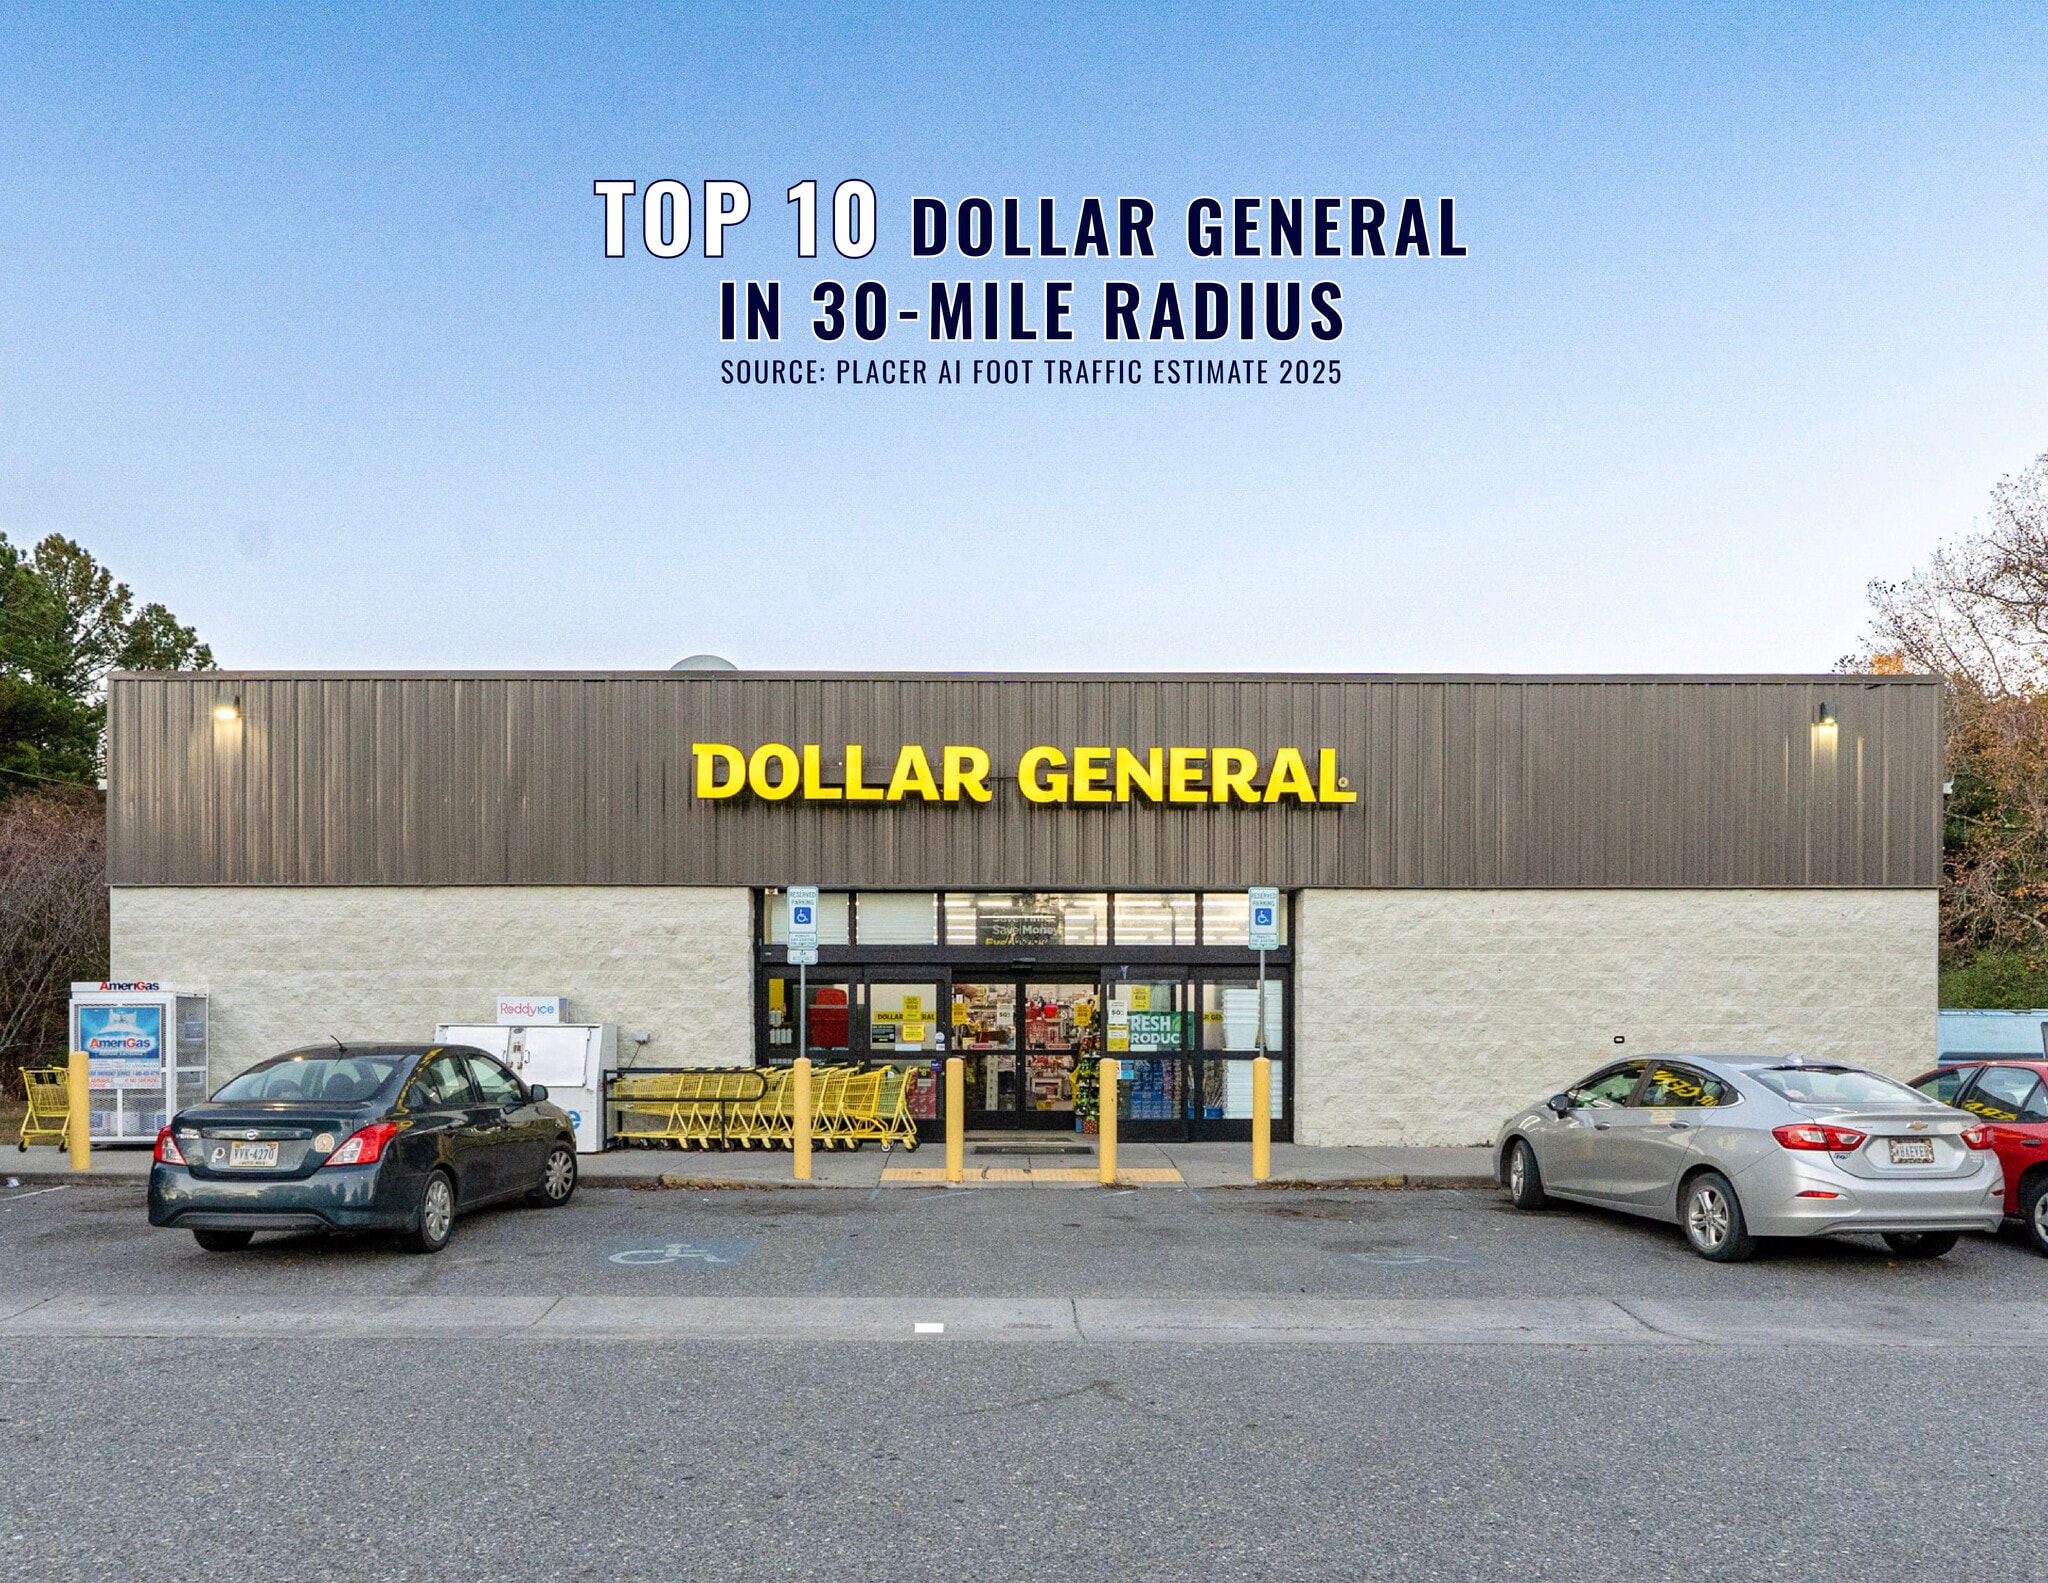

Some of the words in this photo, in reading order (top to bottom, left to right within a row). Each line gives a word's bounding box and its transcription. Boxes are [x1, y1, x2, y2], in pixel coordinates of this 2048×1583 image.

[692, 743, 994, 802] DOLLAR
[1018, 745, 1358, 804] GENERAL
[99, 981, 160, 991] AmeriGas
[89, 1038, 151, 1049] AmeriGas
[1129, 1032, 1181, 1044] RODUC
